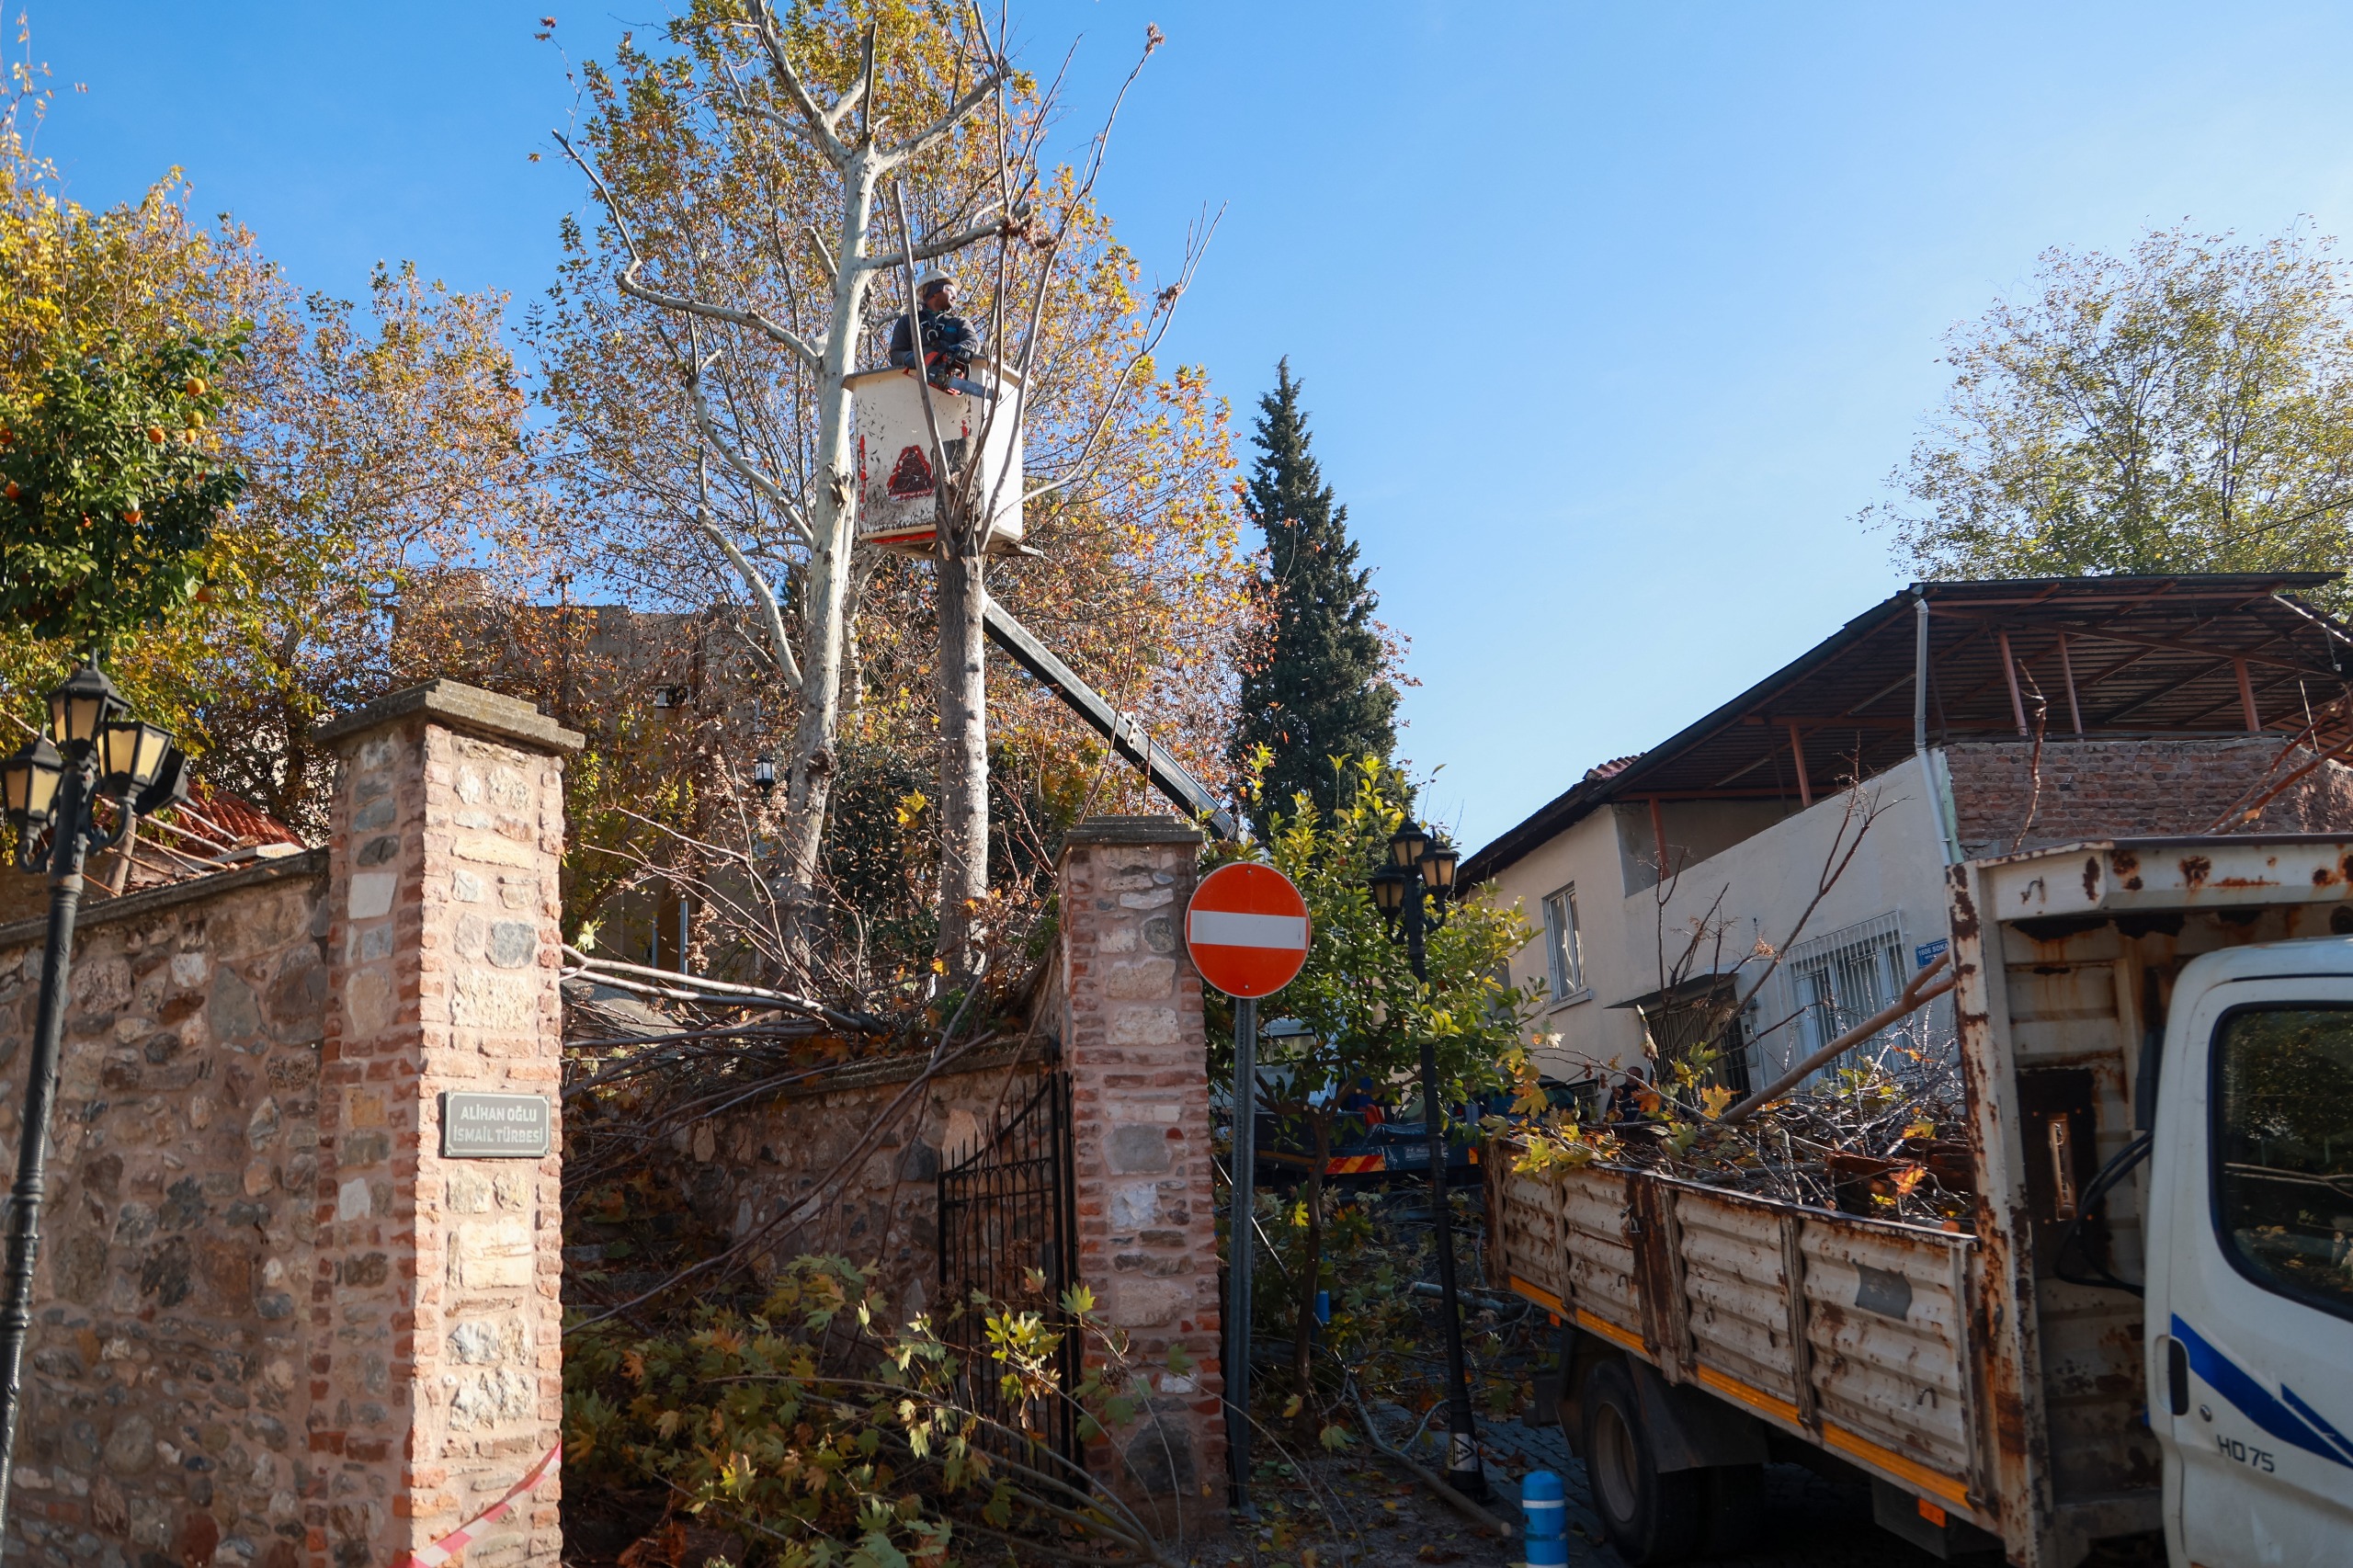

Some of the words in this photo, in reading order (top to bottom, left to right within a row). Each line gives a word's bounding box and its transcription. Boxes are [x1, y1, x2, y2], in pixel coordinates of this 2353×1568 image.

[1932, 943, 1949, 952] SOKA
[460, 1104, 505, 1121] ALİHAN
[507, 1105, 537, 1122] OĞLU
[453, 1124, 494, 1142] İSMAİL
[495, 1126, 543, 1143] TÜRBESİ
[2216, 1435, 2245, 1462] HD
[2248, 1447, 2275, 1473] 75
